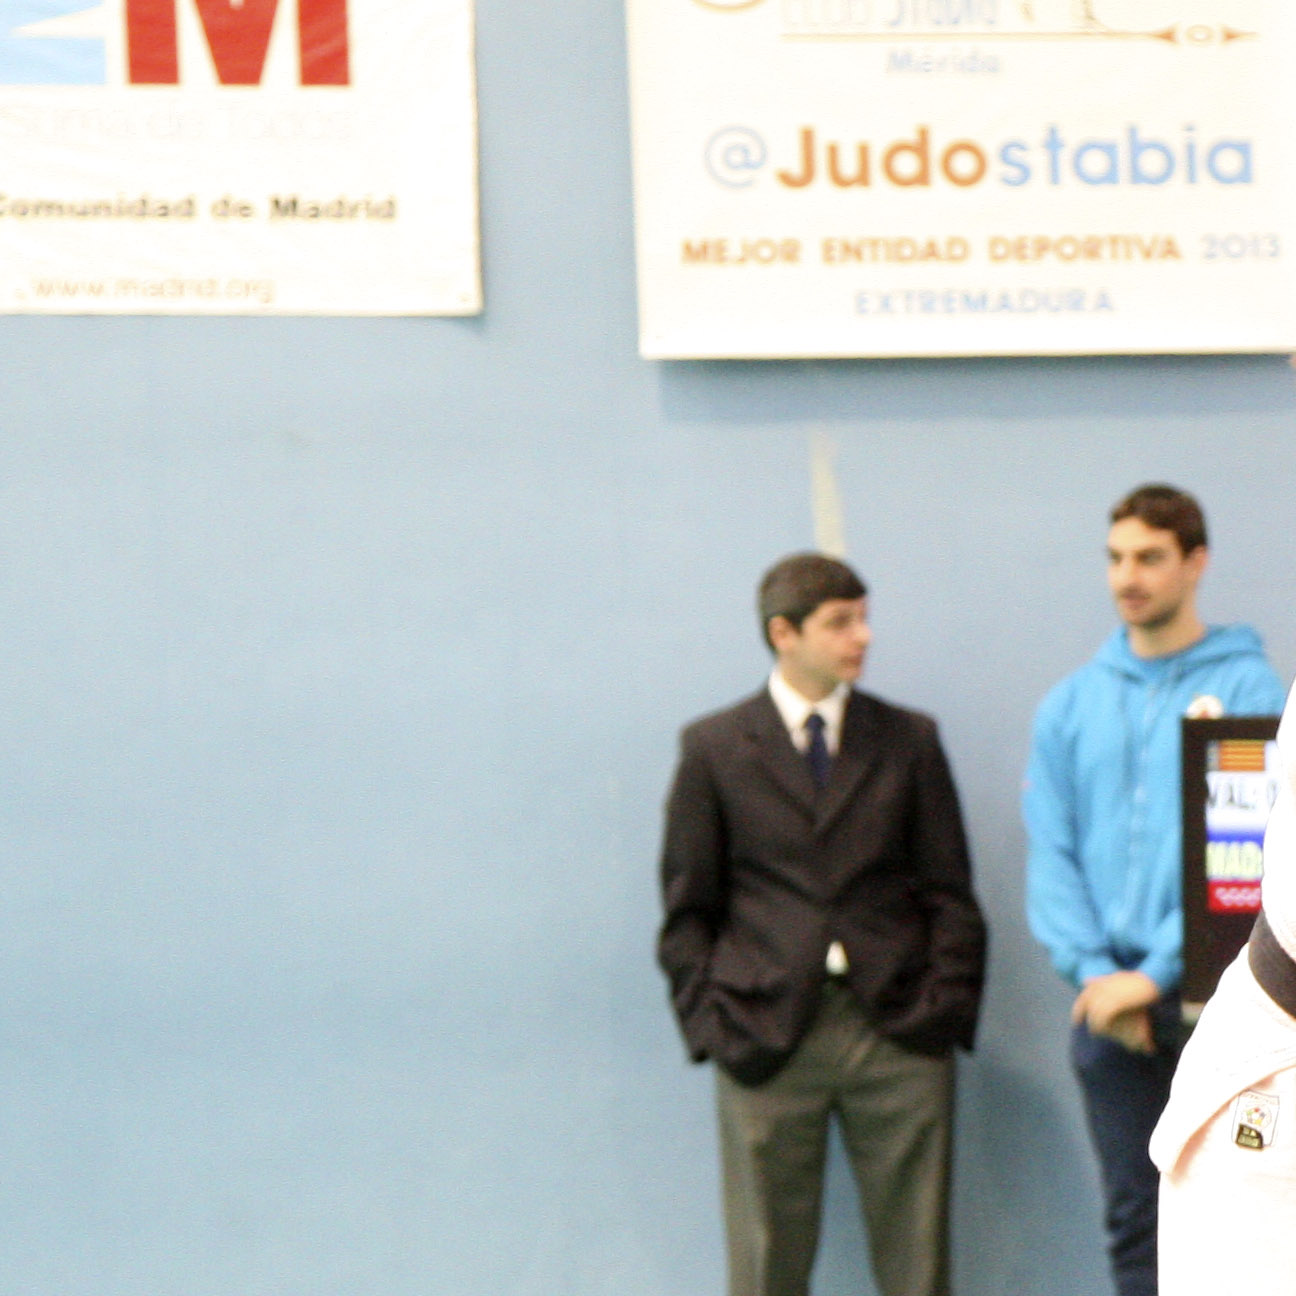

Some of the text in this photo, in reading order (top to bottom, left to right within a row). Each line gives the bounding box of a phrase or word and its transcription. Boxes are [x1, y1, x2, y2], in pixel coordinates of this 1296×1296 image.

[704, 124, 1254, 190] @Judostabia
[0, 194, 397, 220] omunidad de Madrid
[681, 234, 1281, 265] MEJOR ENTIDAD DEPORTIVA 2013
[853, 288, 1115, 316] EXTREMADURA
